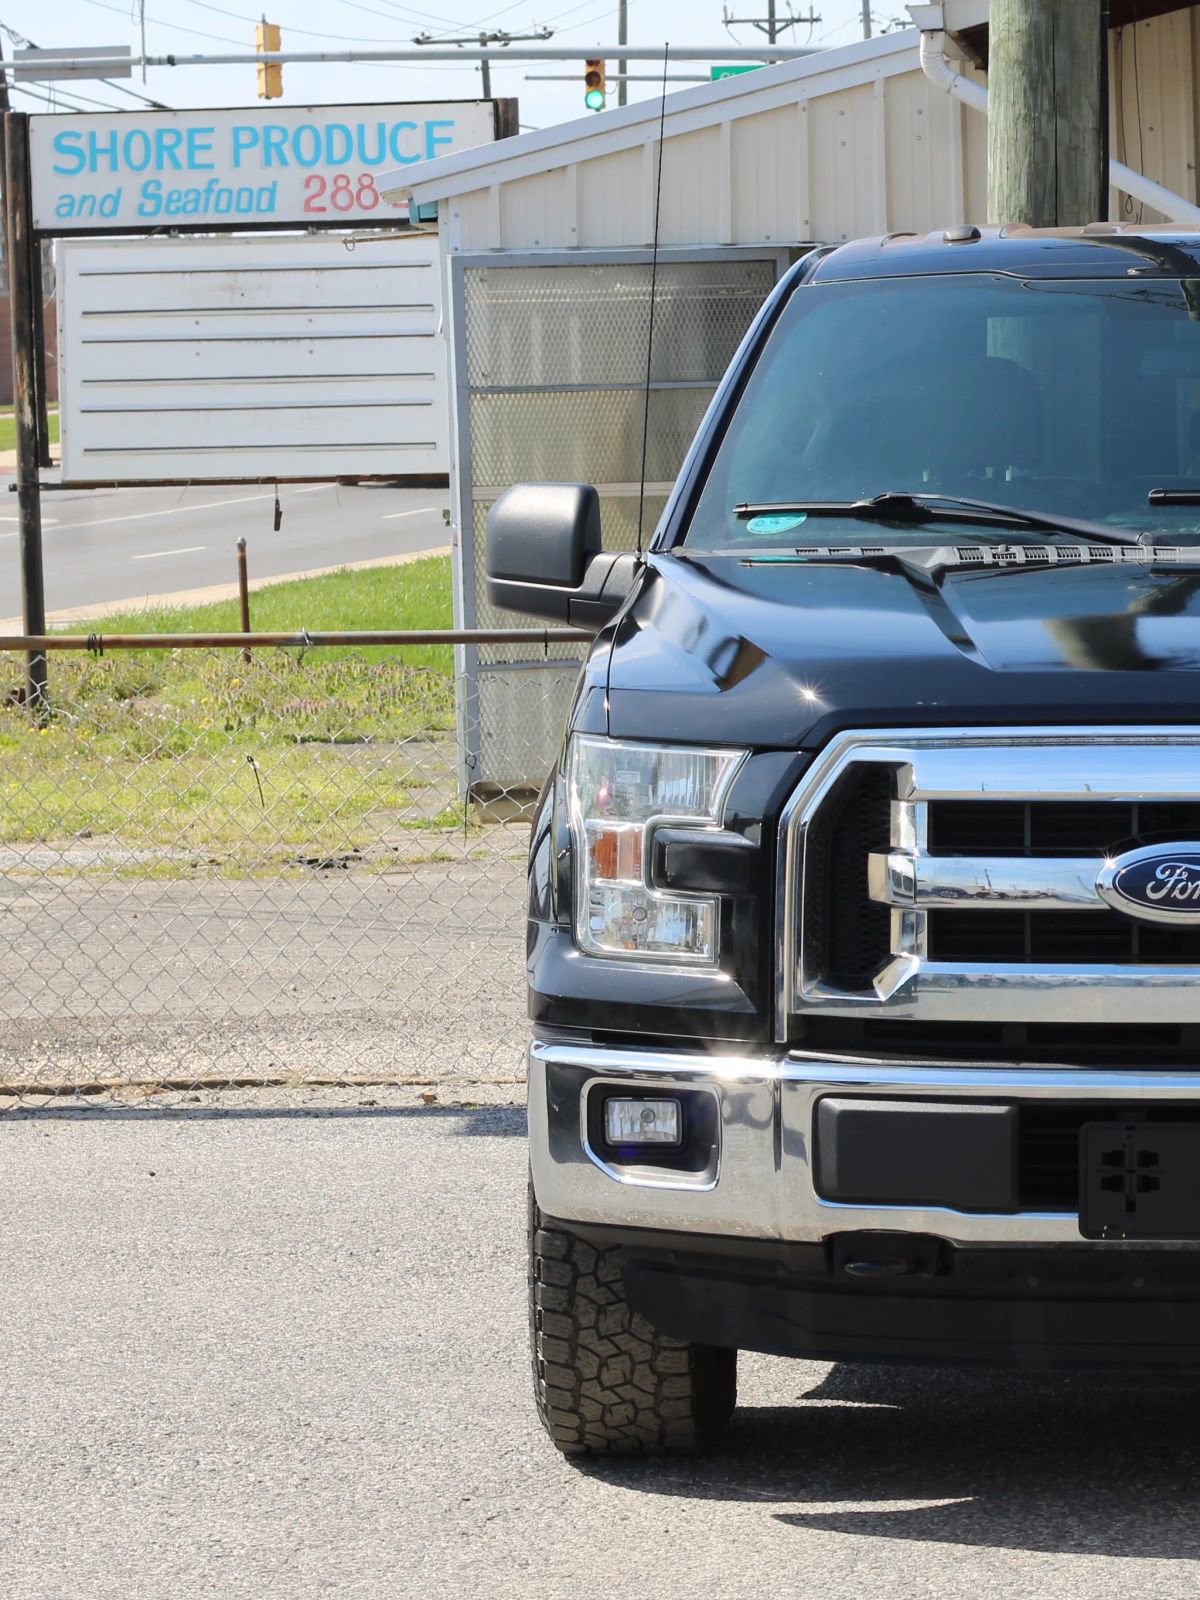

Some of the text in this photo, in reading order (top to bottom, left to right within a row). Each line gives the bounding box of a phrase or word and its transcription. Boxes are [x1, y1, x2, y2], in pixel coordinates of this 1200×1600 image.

[52, 119, 455, 176] SHORE PRODUCE
[55, 187, 123, 218] and
[137, 177, 279, 218] Seafood
